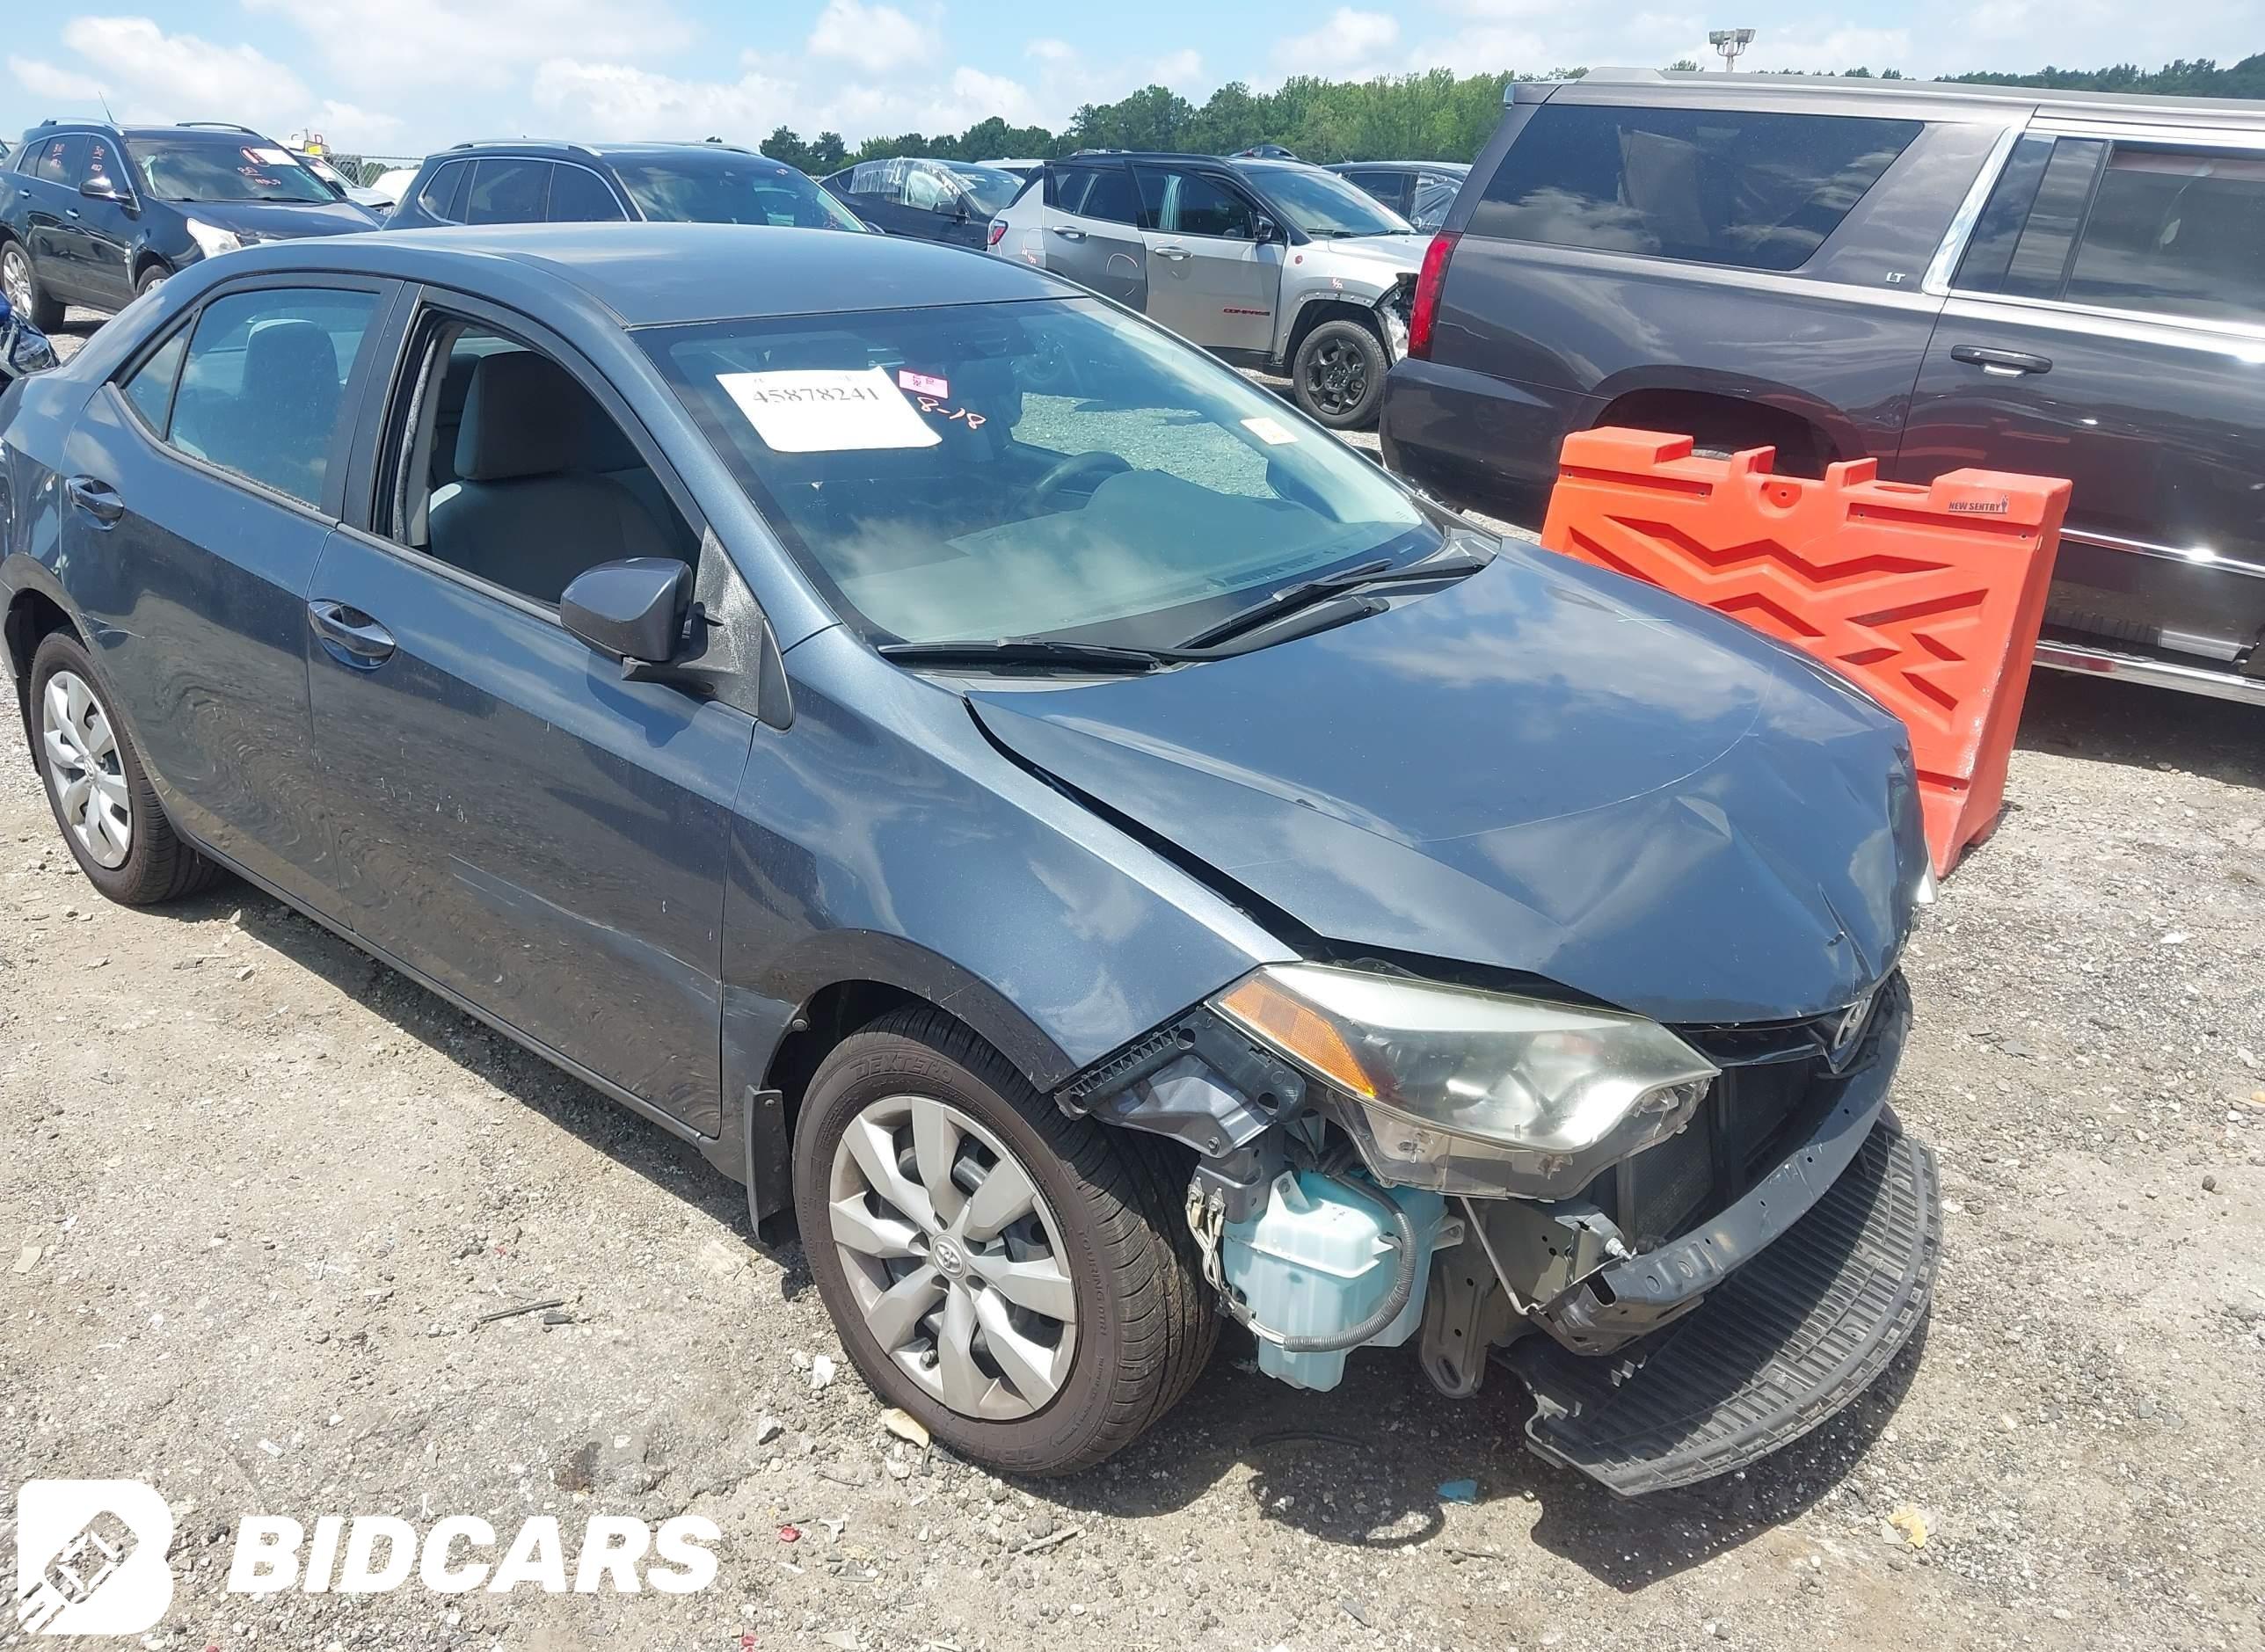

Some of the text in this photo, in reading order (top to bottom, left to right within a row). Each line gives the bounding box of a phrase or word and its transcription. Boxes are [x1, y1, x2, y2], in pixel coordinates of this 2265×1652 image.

[1886, 272, 1906, 283] LT
[1223, 308, 1271, 317] COMPASS
[754, 387, 879, 403] 45878241
[1948, 501, 2000, 512] NEW SENTRY
